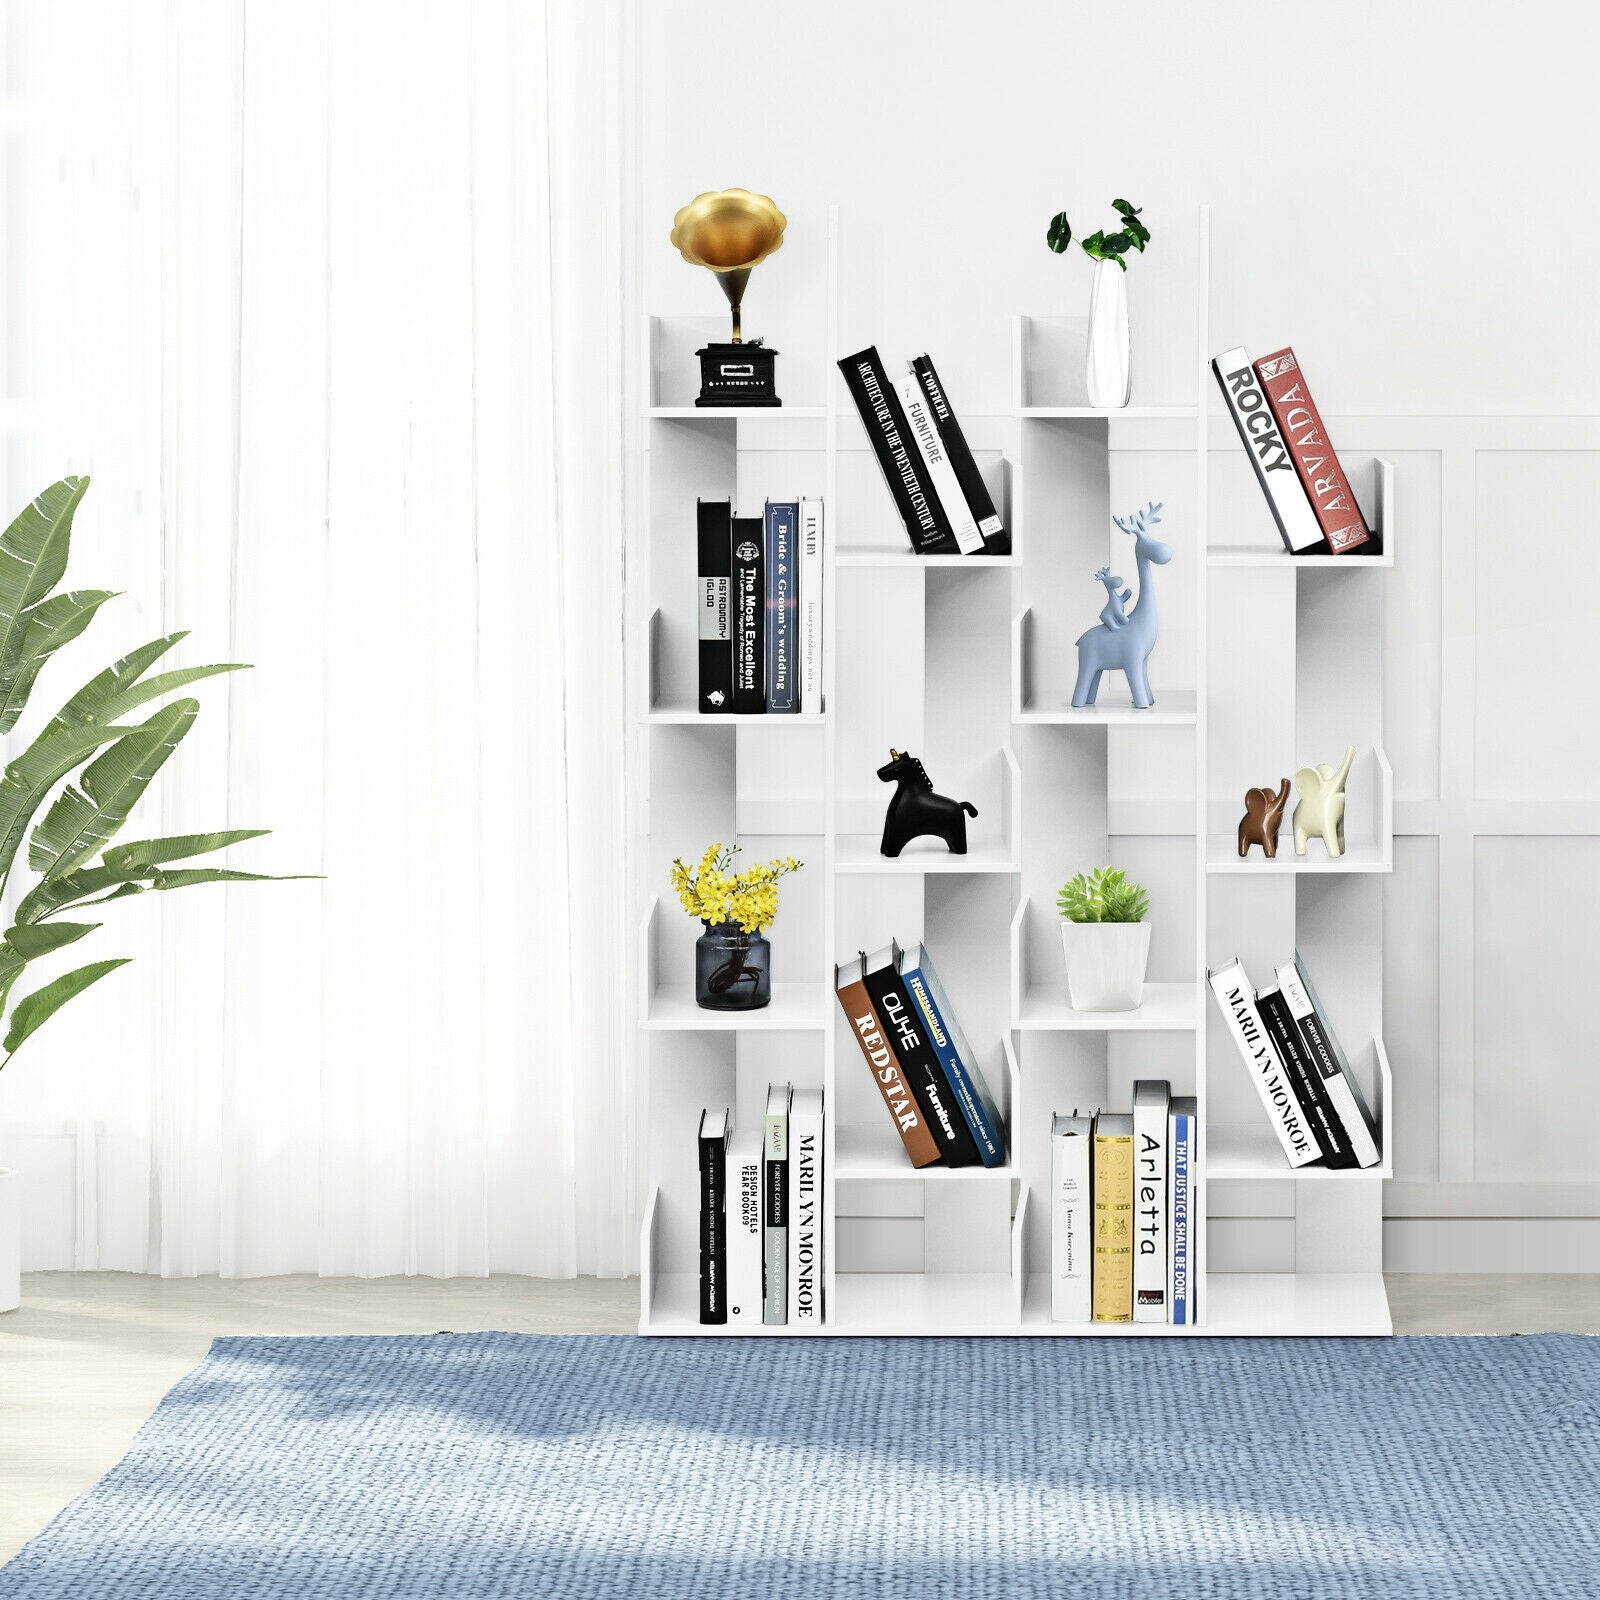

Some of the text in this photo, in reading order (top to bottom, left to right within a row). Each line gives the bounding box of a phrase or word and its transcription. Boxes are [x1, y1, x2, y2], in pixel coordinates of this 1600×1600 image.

[880, 419, 896, 432] IN
[885, 429, 902, 449] THE
[907, 402, 942, 464] FURNITURE
[1226, 366, 1293, 473] ROCKY
[1277, 382, 1350, 510] ARVADA
[892, 445, 921, 495] TWENTIETH
[806, 517, 816, 555] LUXURY
[910, 492, 936, 530] CENTURY
[706, 578, 714, 607] IGLOO
[745, 567, 756, 592] The
[718, 578, 726, 638] ASTRONOMY
[745, 595, 756, 627] Most
[775, 525, 787, 690] Bride & Groom's wedding
[744, 630, 756, 690] Excellent
[854, 1011, 918, 1133] REDSTAR
[1225, 987, 1310, 1156] MARILYN MONROE
[1286, 1041, 1298, 1059] REVIEW
[1295, 1059, 1307, 1078] DESIGN
[1305, 1018, 1335, 1074] FOREVER GODDESS
[925, 1083, 955, 1140] Furniture
[949, 1058, 961, 1078] Family
[978, 1125, 988, 1140] since
[1303, 1078, 1317, 1102] INTERIOR
[741, 1165, 749, 1188] YEAR
[749, 1165, 758, 1234] DESIGN HOTELS
[1140, 1133, 1162, 1255] Arletta
[798, 1135, 814, 1318] MARILYN MONROE
[1174, 1139, 1187, 1302] THAT JUSTICE SHALL BE DONE
[773, 1260, 781, 1273] AGE
[773, 1274, 781, 1284] OF
[773, 1285, 781, 1314] FASHION
